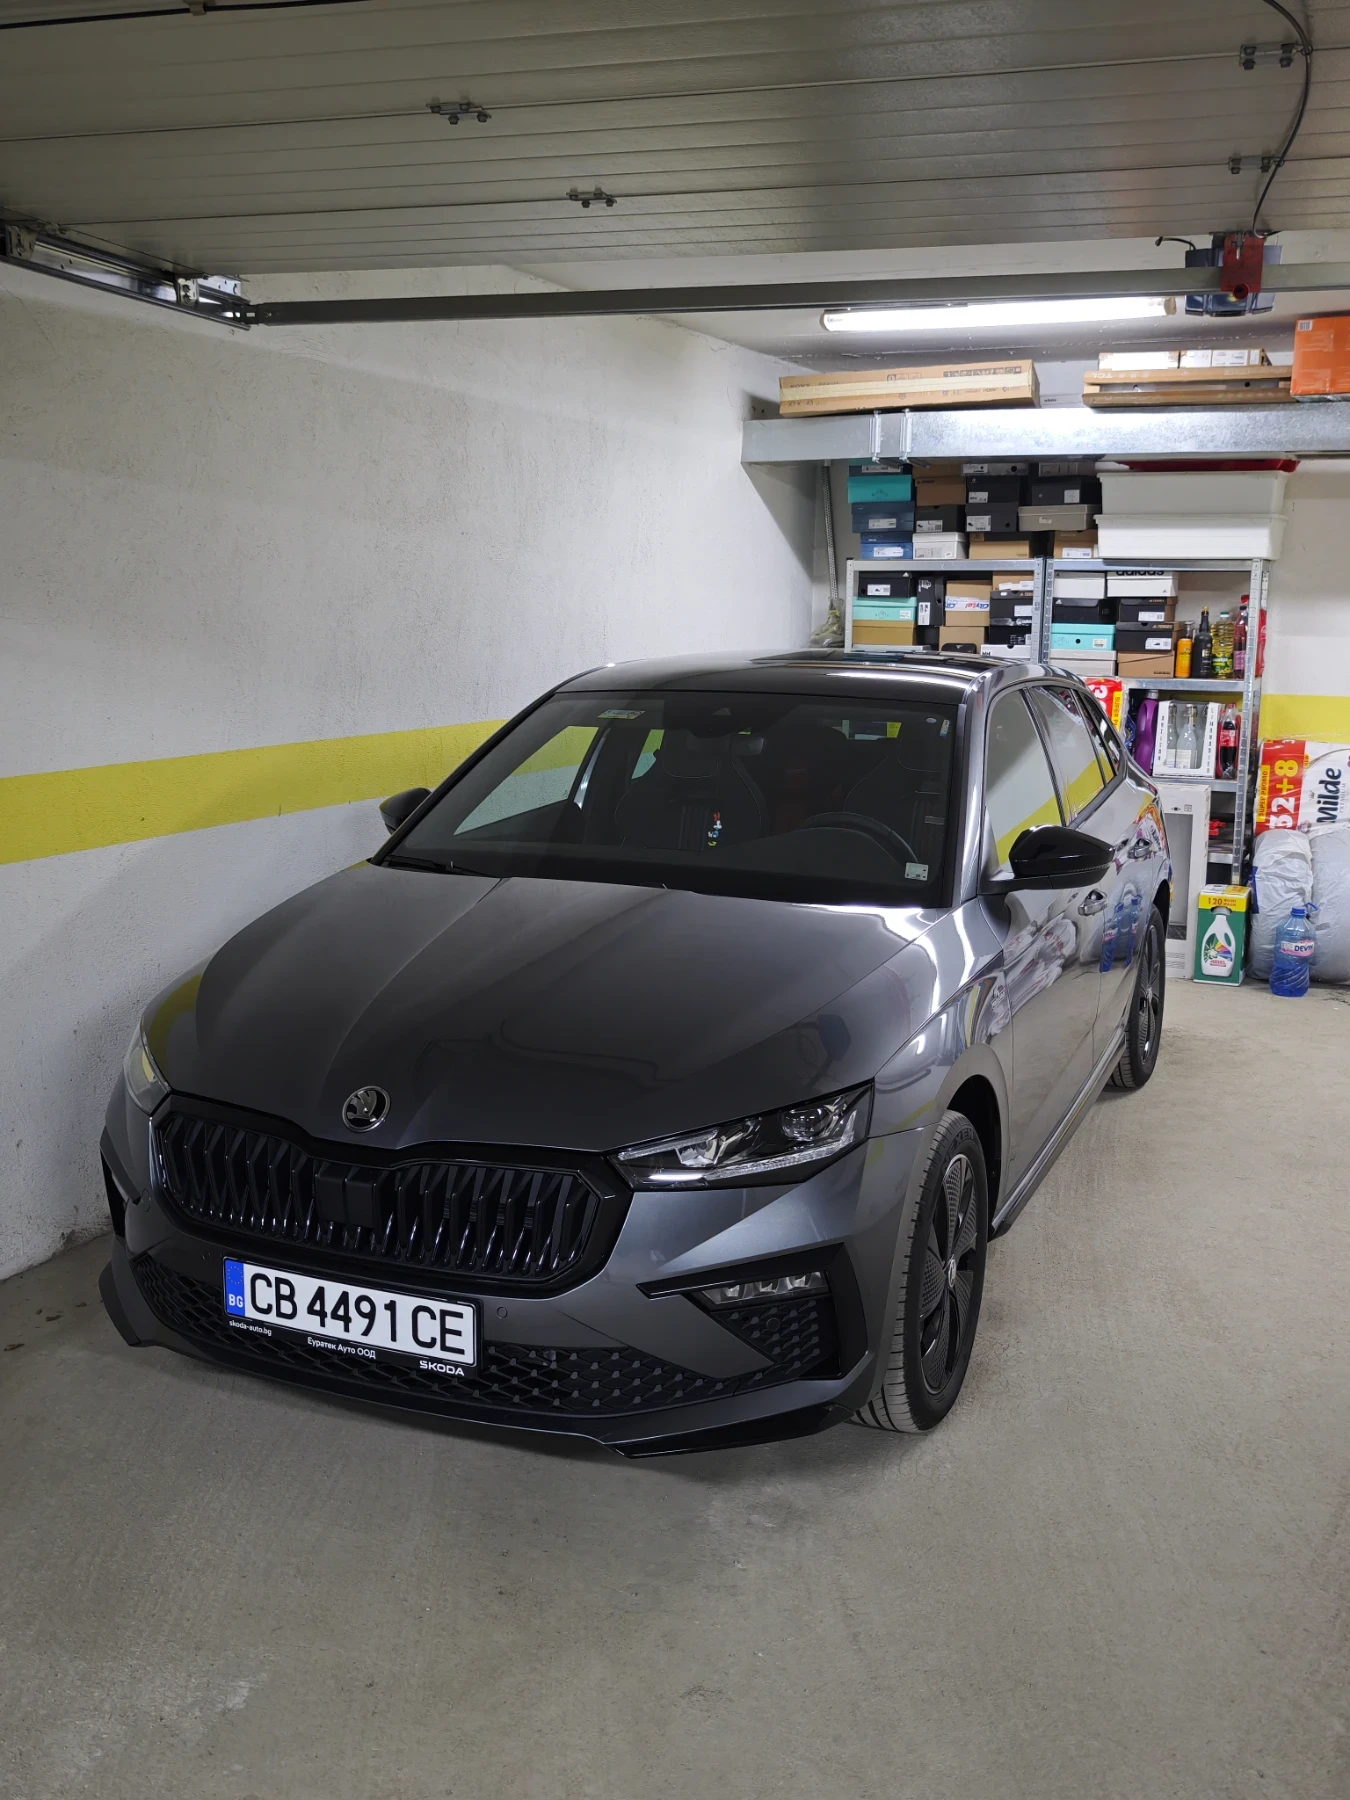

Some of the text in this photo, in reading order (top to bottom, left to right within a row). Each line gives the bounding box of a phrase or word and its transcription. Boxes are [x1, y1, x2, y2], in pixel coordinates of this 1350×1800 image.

[1258, 770, 1268, 817] SUPER PROMO
[1316, 767, 1342, 823] Milde
[228, 1293, 244, 1309] BG
[250, 1272, 466, 1356] CB 4491 CE
[229, 1319, 272, 1337] skoda-auto.bg
[307, 1337, 376, 1360] Еуратек Ауто ООД
